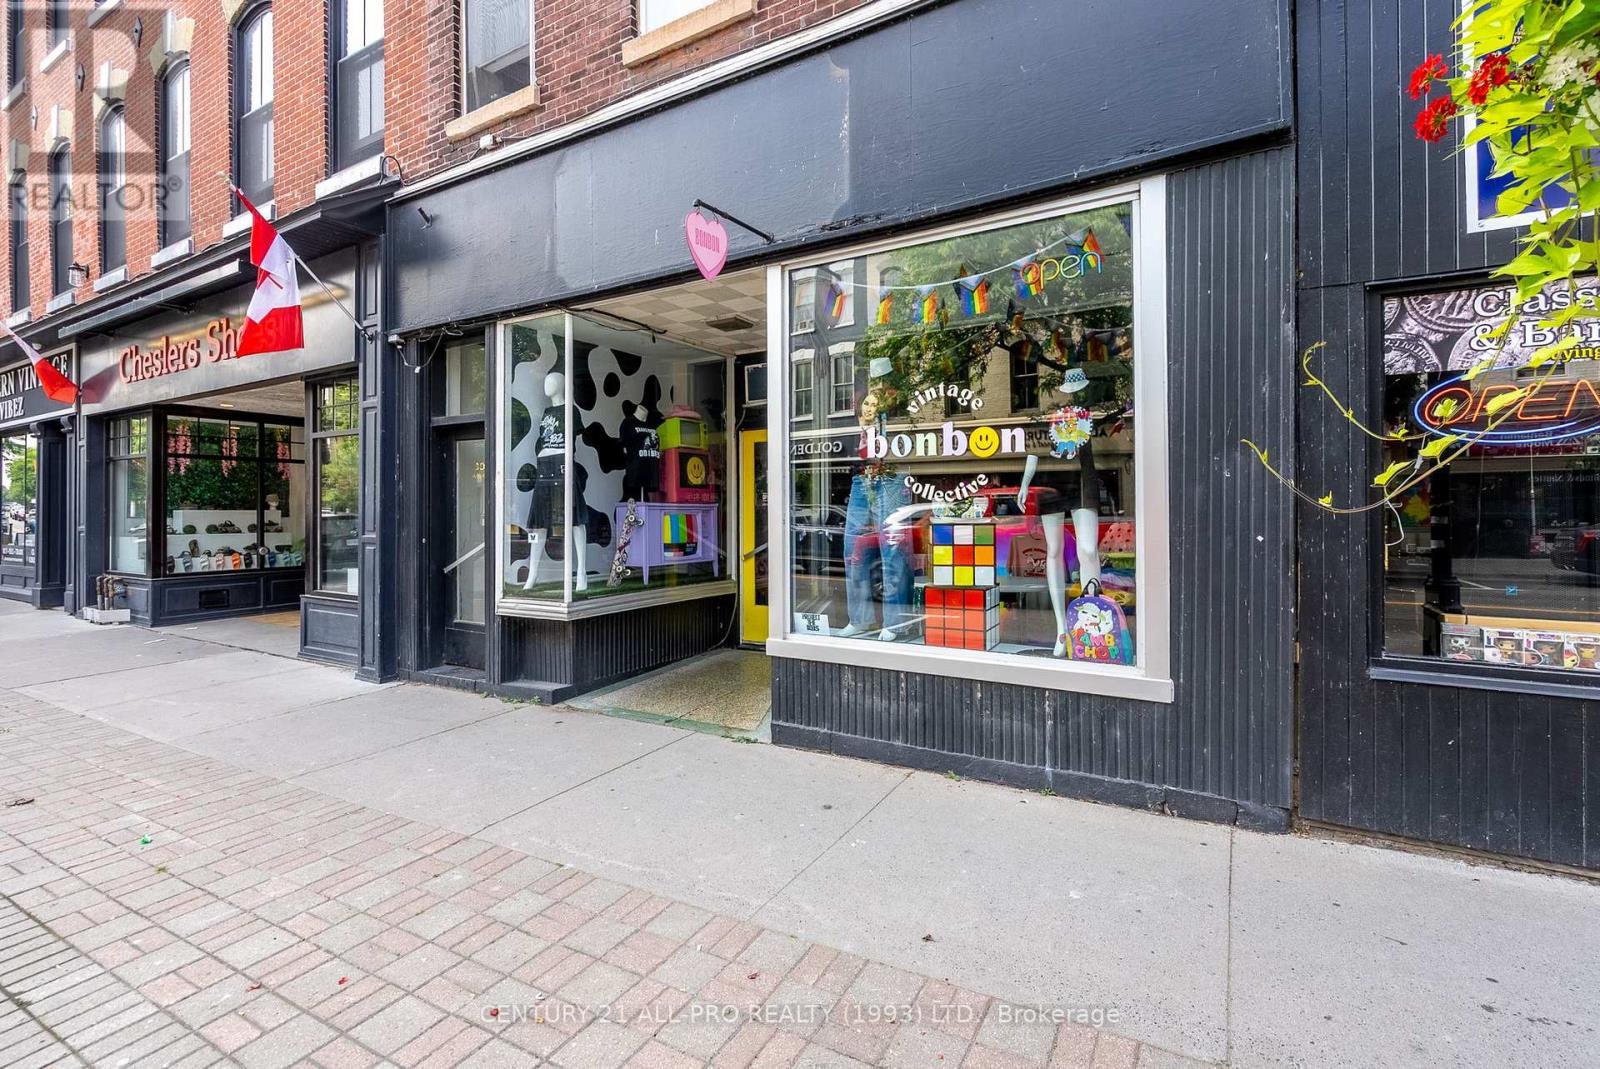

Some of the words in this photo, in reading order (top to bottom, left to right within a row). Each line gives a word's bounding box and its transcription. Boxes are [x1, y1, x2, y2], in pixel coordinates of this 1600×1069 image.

[695, 227, 720, 253] BONBON
[1020, 251, 1101, 290] open
[119, 335, 201, 384] Cheslers
[907, 381, 984, 414] vintage
[904, 473, 989, 502] collective
[1074, 644, 1120, 660] CHOP
